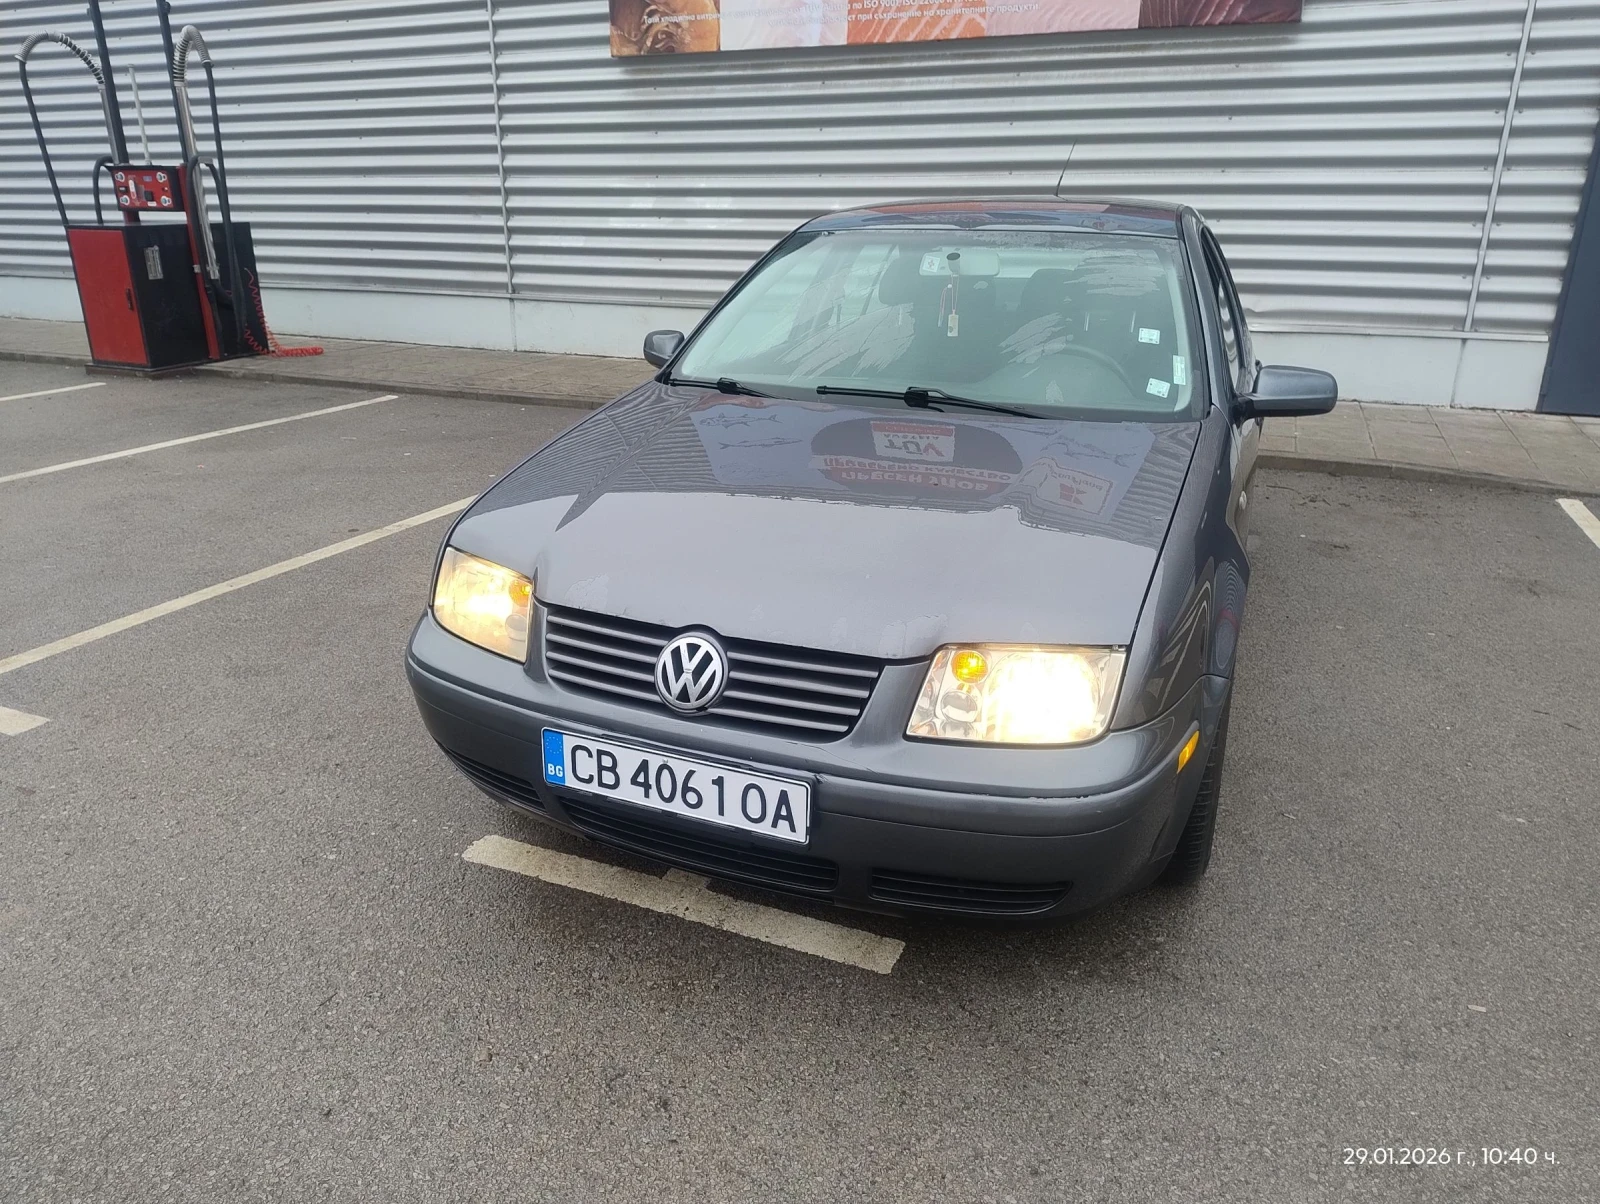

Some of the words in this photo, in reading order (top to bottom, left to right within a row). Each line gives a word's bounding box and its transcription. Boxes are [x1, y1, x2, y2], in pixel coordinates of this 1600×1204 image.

[864, 0, 879, 8] ISO
[547, 763, 564, 778] BG
[570, 744, 621, 790] CB
[630, 758, 725, 817] 4061
